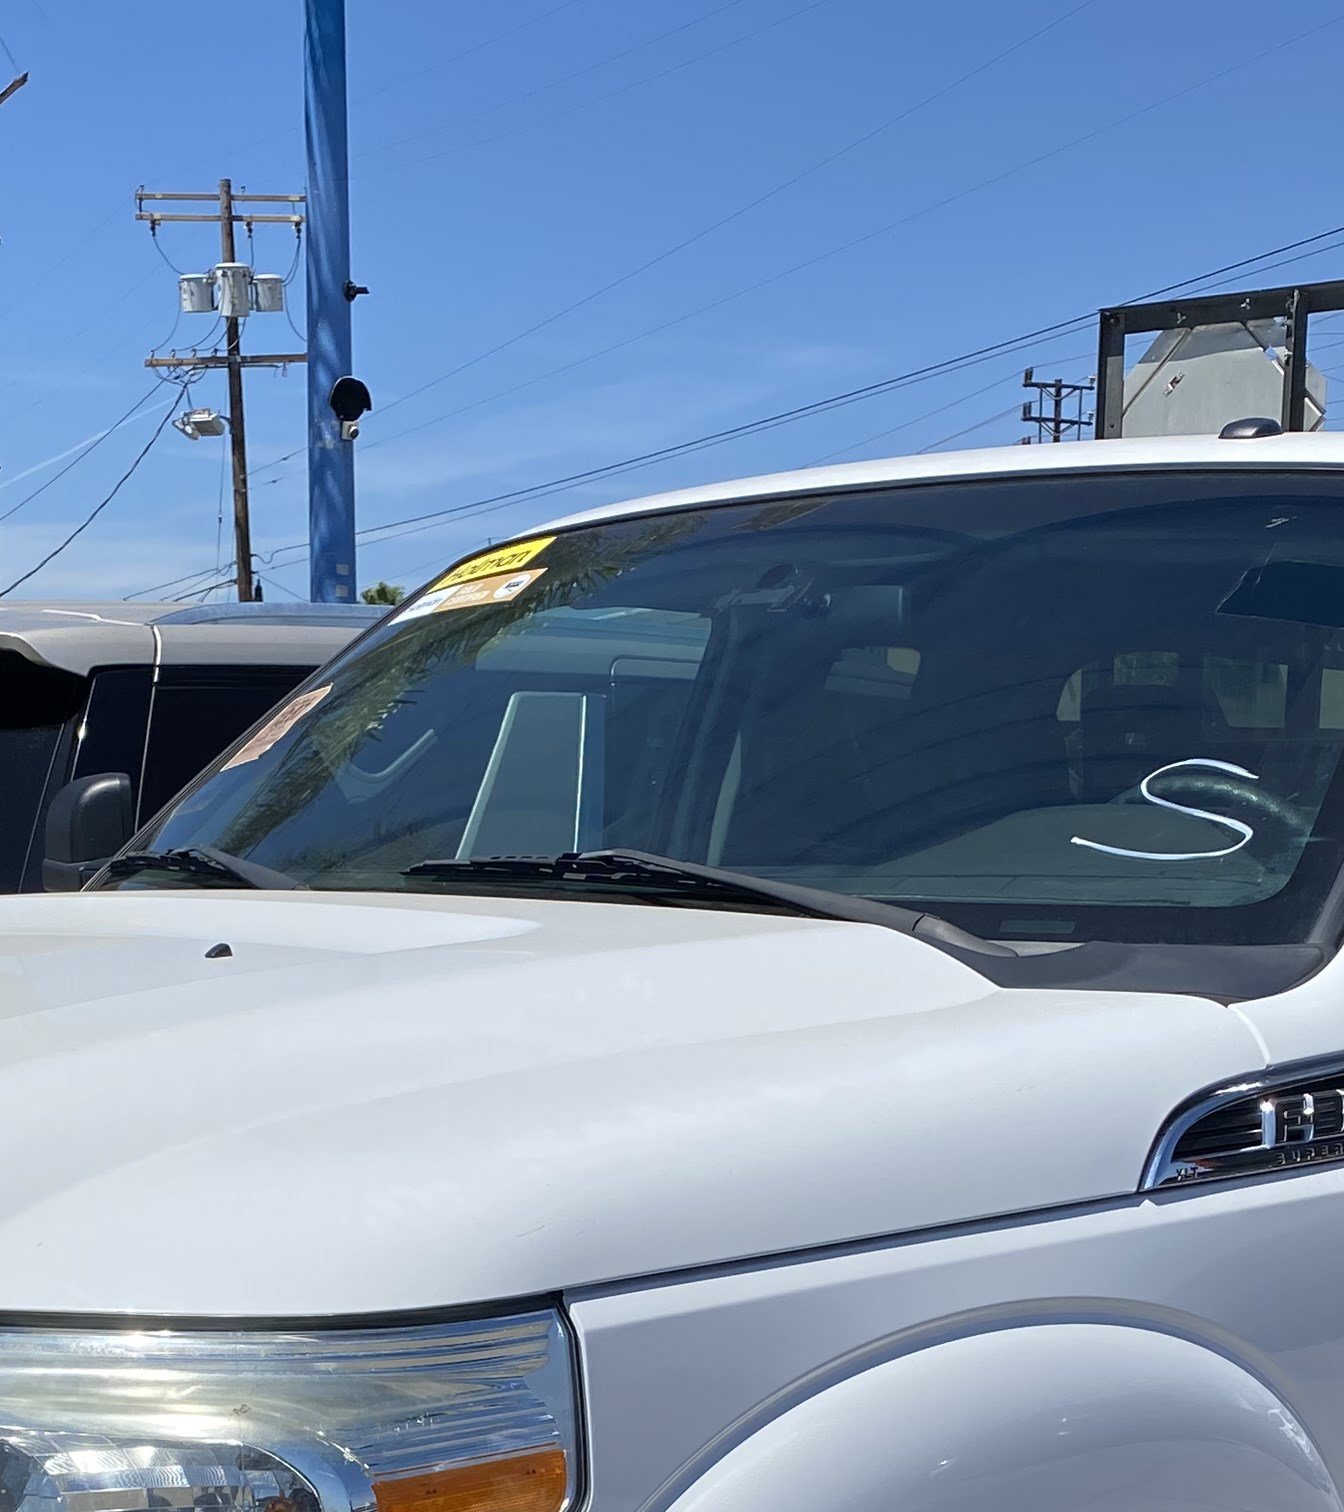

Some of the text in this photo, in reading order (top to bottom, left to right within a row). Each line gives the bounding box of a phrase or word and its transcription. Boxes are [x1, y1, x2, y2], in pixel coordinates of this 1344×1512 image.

[1070, 758, 1260, 862] S
[1275, 1140, 1344, 1166] SUPER
[1175, 1166, 1199, 1182] XLT
